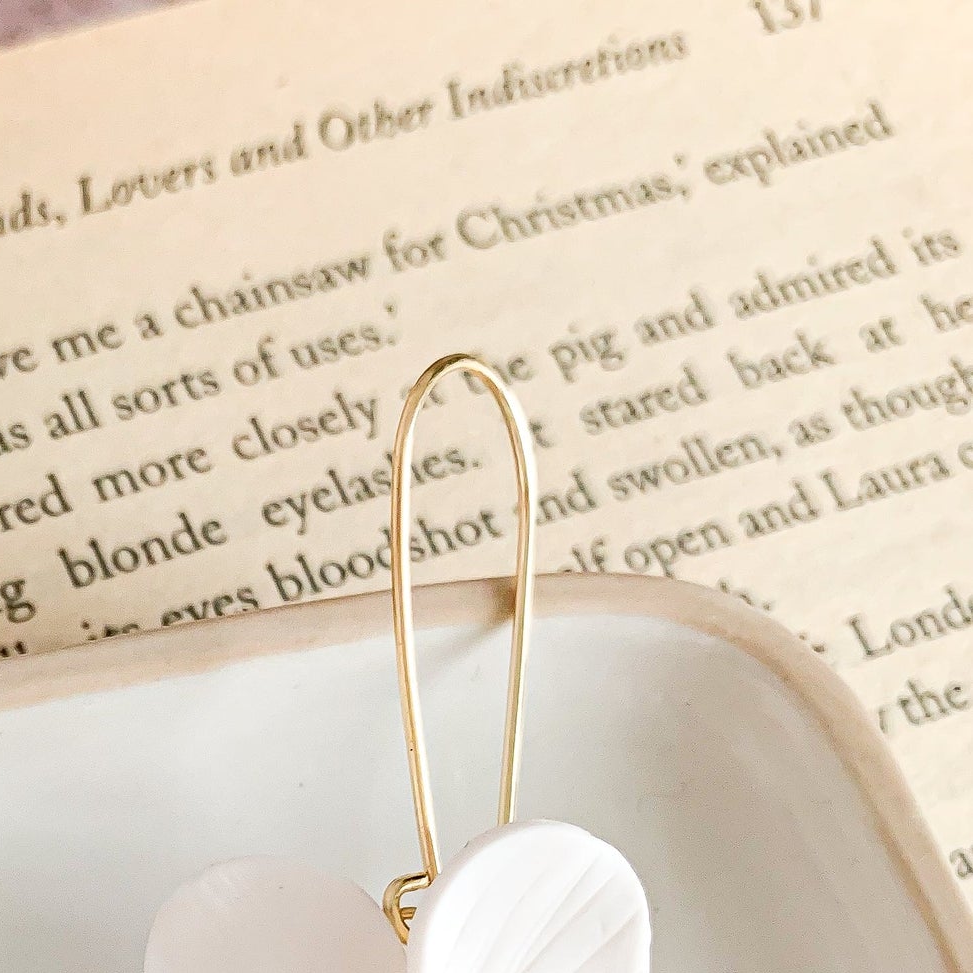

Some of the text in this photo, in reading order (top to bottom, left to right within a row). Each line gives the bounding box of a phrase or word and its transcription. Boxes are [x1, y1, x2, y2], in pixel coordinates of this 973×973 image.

[78, 153, 218, 216] Lovers
[229, 121, 308, 177] and
[317, 98, 433, 151] Other
[443, 32, 688, 120] Indiscretions
[51, 321, 125, 364] me
[133, 310, 164, 342] a
[173, 253, 373, 331] chainsaw
[382, 227, 448, 273] for
[703, 98, 895, 187] explained
[44, 389, 102, 441] all
[111, 367, 222, 420] sorts
[232, 332, 283, 386] of
[57, 510, 230, 590] blonde
[578, 364, 711, 436] stared
[727, 327, 837, 391] back
[858, 315, 906, 353] at
[91, 445, 213, 503] more
[231, 392, 381, 460] closely
[548, 321, 626, 384] pig
[634, 285, 717, 346] and
[729, 235, 899, 321] admired
[903, 225, 963, 267] its
[265, 509, 504, 602] bloodshot
[513, 468, 598, 526] nd
[606, 434, 785, 501] swollen,
[788, 412, 834, 449] as
[623, 517, 732, 578] open
[738, 476, 822, 538] and
[818, 453, 951, 512] Laura
[847, 583, 973, 659] Lond
[897, 679, 970, 726] the
